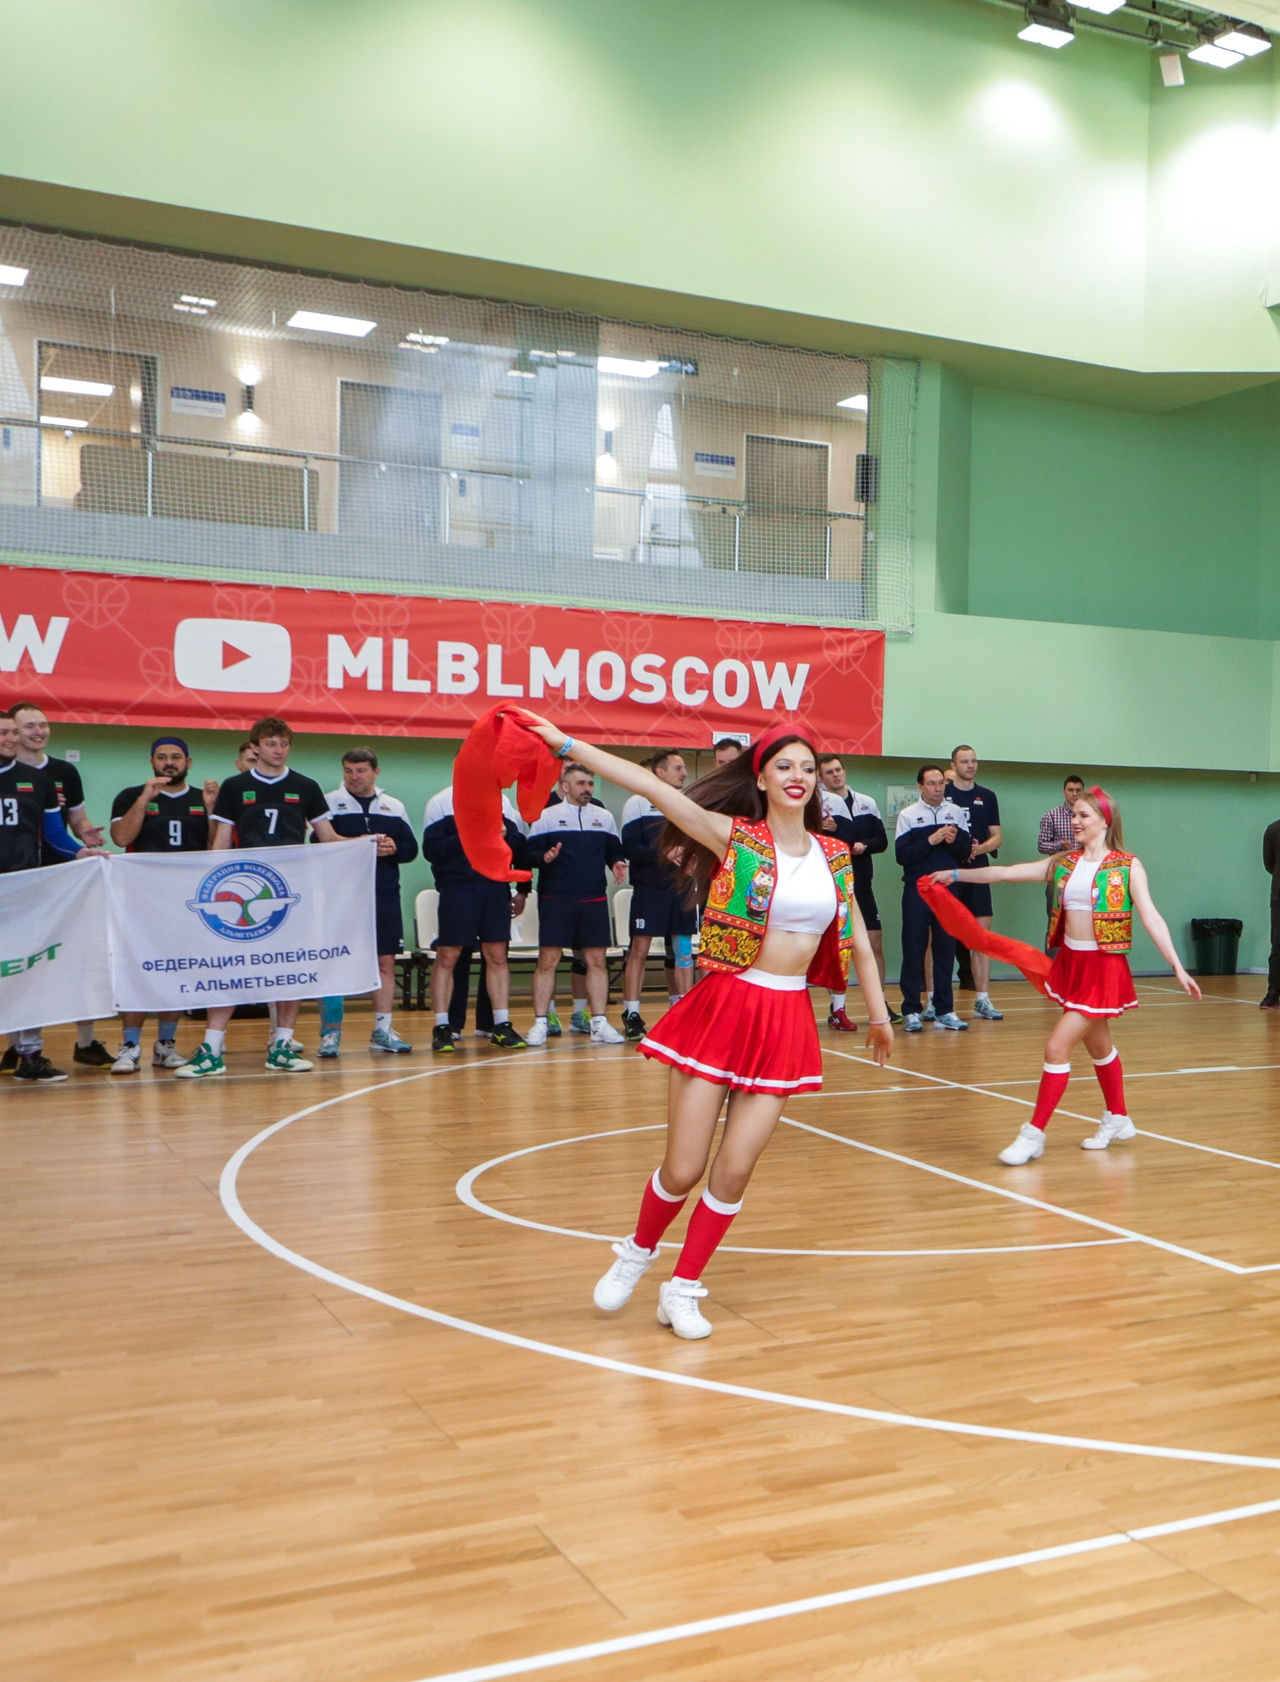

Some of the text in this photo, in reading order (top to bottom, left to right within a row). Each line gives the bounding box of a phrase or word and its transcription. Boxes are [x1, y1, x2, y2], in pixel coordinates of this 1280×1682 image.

[327, 633, 810, 711] MLBLMOSCOW
[168, 820, 182, 846] 9
[264, 808, 279, 835] 7
[635, 918, 646, 930] 19
[142, 945, 351, 973] ФЕДЕРАЦИЯ ВОЛЕЙБОЛА
[180, 972, 319, 994] г. АЛЬМЕТЬЕВСК
